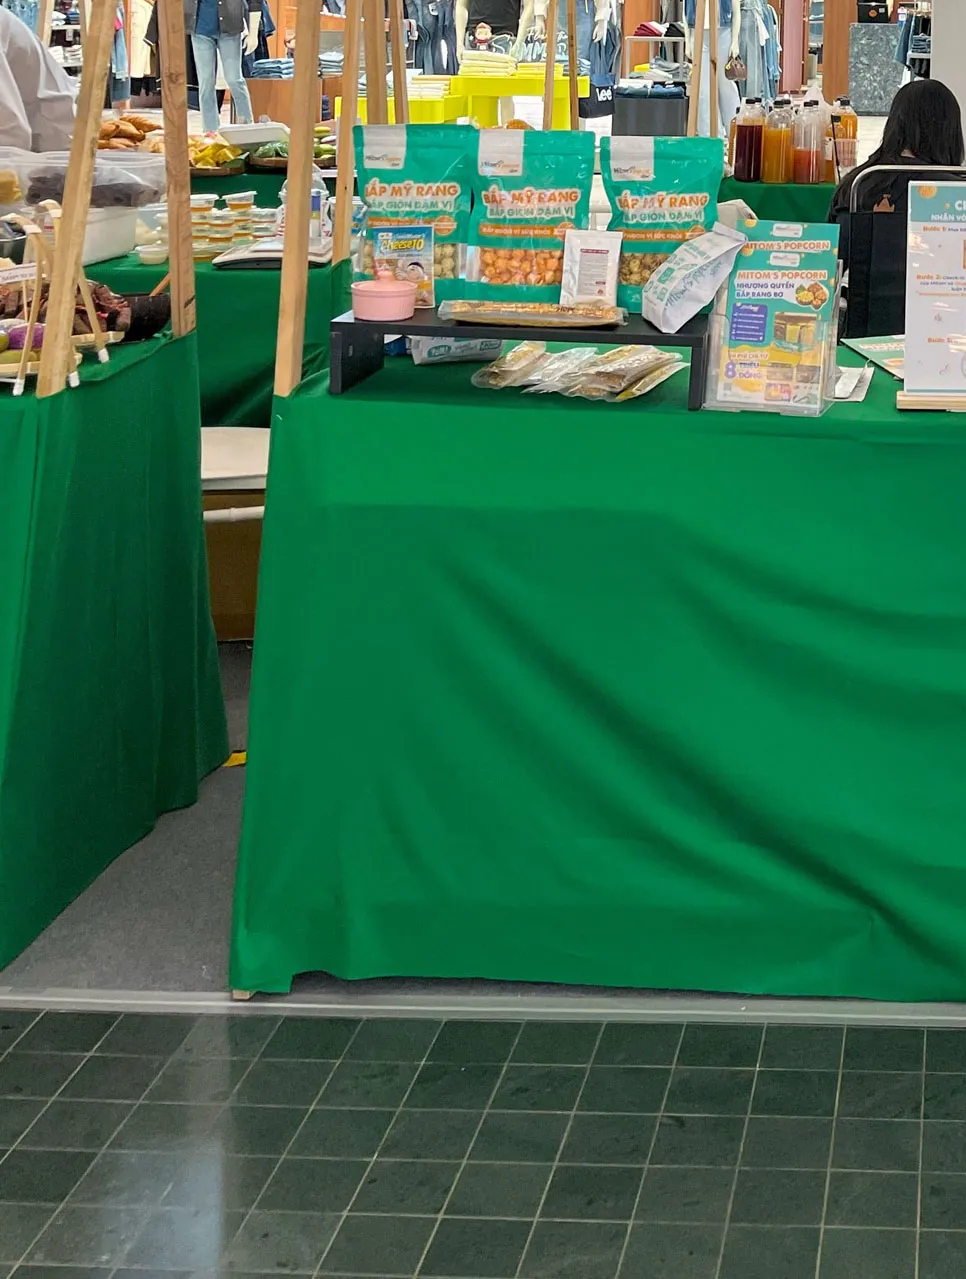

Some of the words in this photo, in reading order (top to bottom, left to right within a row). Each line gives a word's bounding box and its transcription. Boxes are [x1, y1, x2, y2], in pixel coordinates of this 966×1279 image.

[416, 185, 458, 197] RANG
[784, 241, 830, 250] POPCORN
[781, 271, 826, 279] POPCORN
